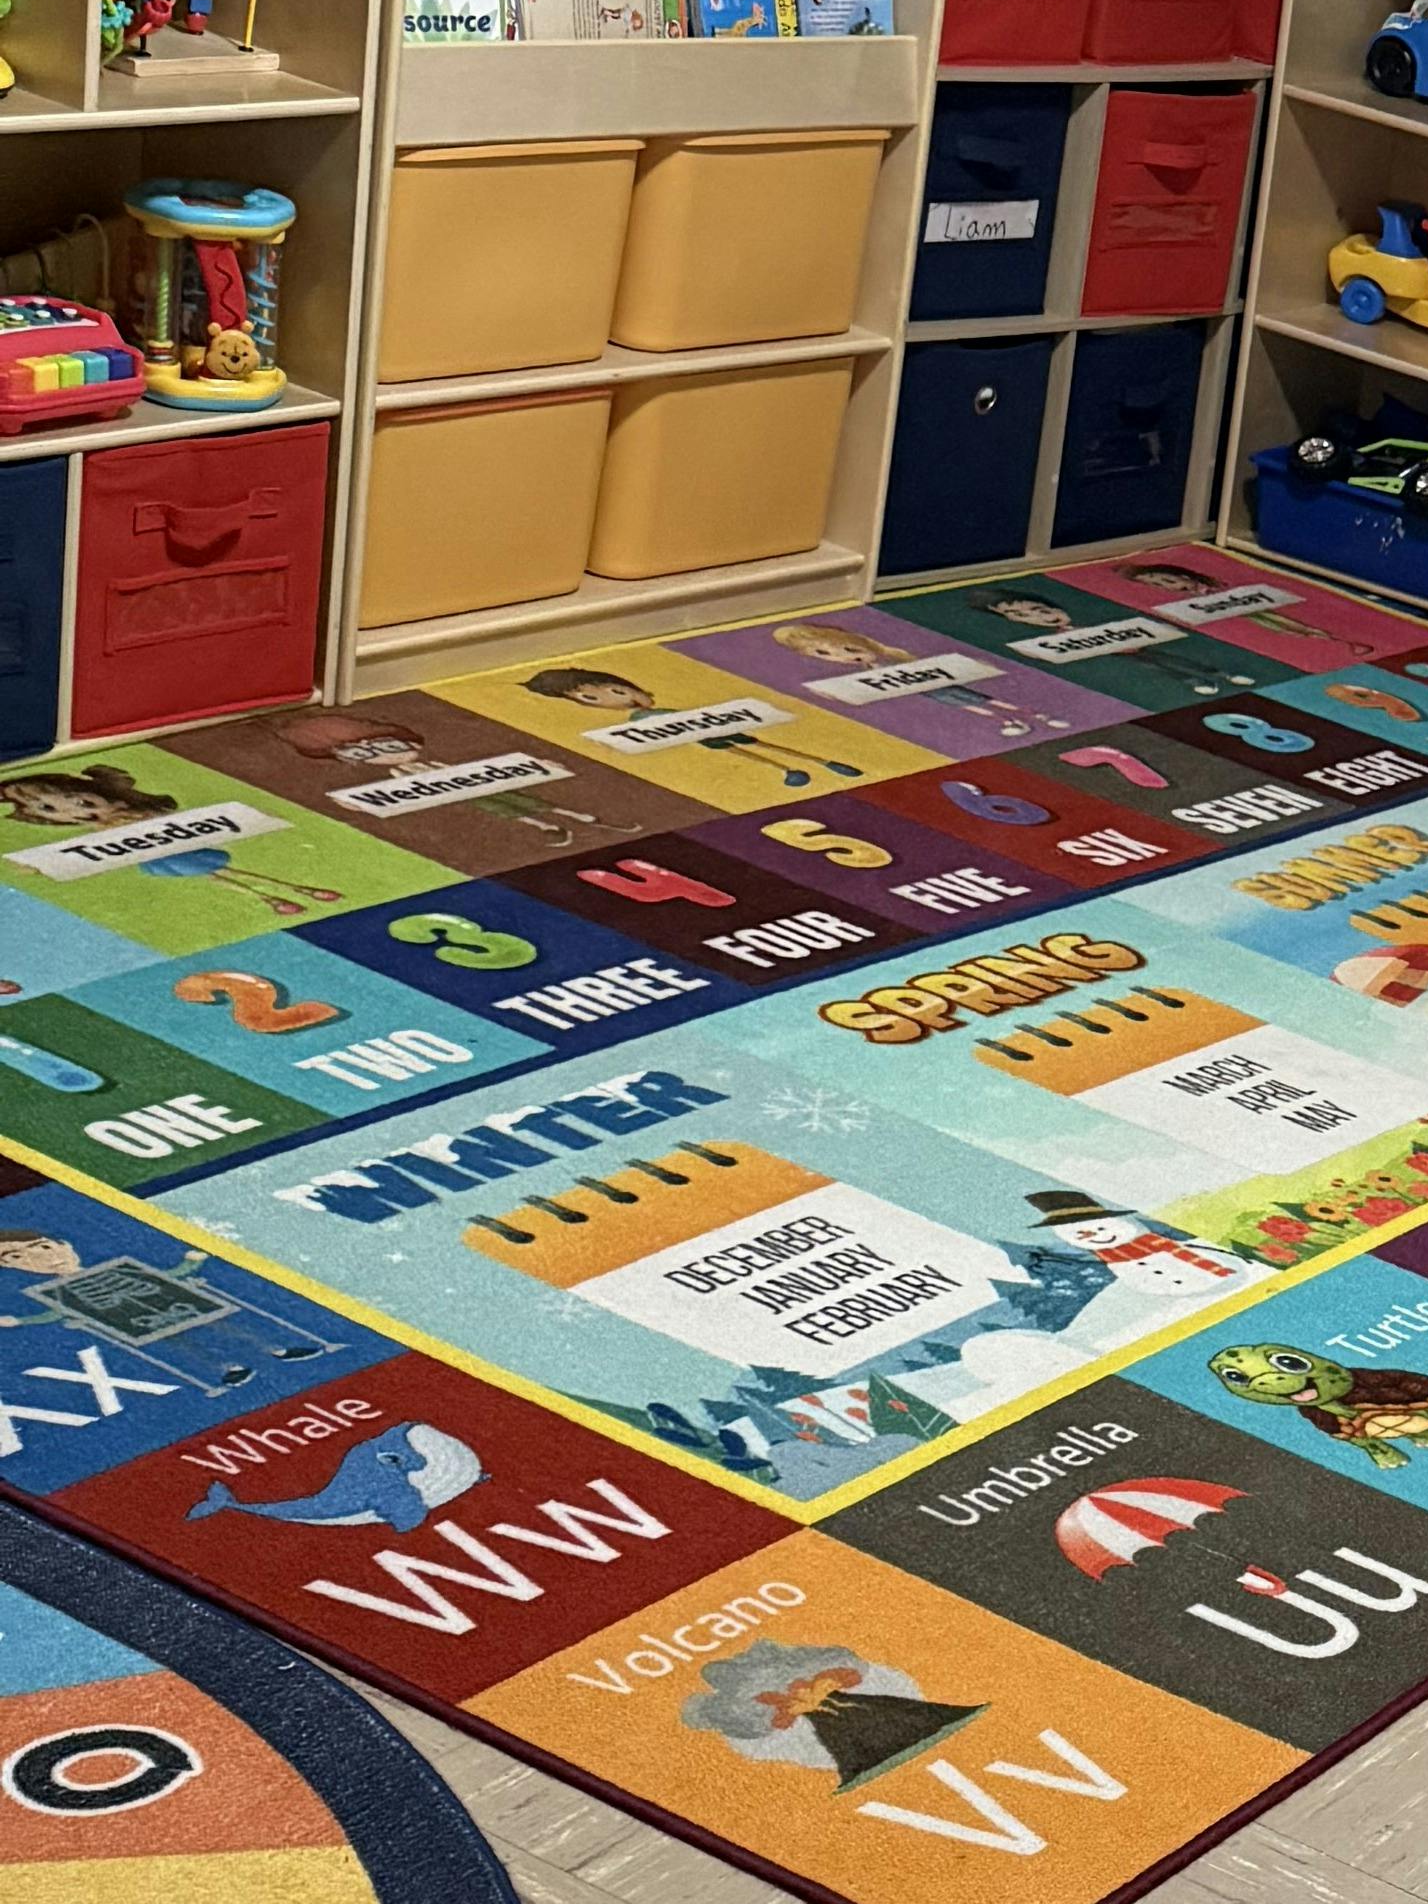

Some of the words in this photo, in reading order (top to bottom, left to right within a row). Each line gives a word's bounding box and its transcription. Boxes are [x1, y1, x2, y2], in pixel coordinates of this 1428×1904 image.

[404, 12, 491, 33] source
[944, 206, 1006, 241] Liam
[1187, 583, 1282, 621] Sunday
[1041, 619, 1155, 657] Saturday
[858, 656, 958, 696] Friday
[1323, 682, 1423, 724] 9
[610, 702, 767, 746] Thursday
[1204, 712, 1316, 755] 8
[350, 756, 552, 816] Wednesday
[1059, 744, 1169, 790] 7
[940, 780, 1052, 827] 6
[1173, 785, 1325, 834] SEVEN
[60, 810, 244, 866] Tuesday
[759, 818, 893, 870] 5
[1057, 829, 1170, 872] SIX
[576, 859, 737, 908] 4
[890, 867, 1031, 917] FIVE
[388, 912, 539, 970] 3
[702, 910, 876, 970] FOUR
[171, 969, 342, 1036] 2
[492, 956, 712, 1033] THREE
[818, 933, 1147, 1044] SPRING
[291, 1028, 476, 1093] TWO
[1161, 1051, 1267, 1101] MARCH
[1226, 1076, 1316, 1119] APRIL
[1279, 1097, 1361, 1135] MAY
[83, 1094, 265, 1161] ONE
[272, 1070, 731, 1224] WINTER
[663, 1215, 857, 1296] DECEMBER
[740, 1244, 896, 1316] JANUARY
[783, 1264, 964, 1346] FEBRUARY
[180, 1392, 384, 1482] Whale
[917, 1416, 1140, 1530] Umbrella
[302, 1477, 675, 1637] Ww
[566, 1577, 810, 1697] Volcano
[1, 1723, 204, 1817] O
[856, 1729, 1130, 1858] Vv
